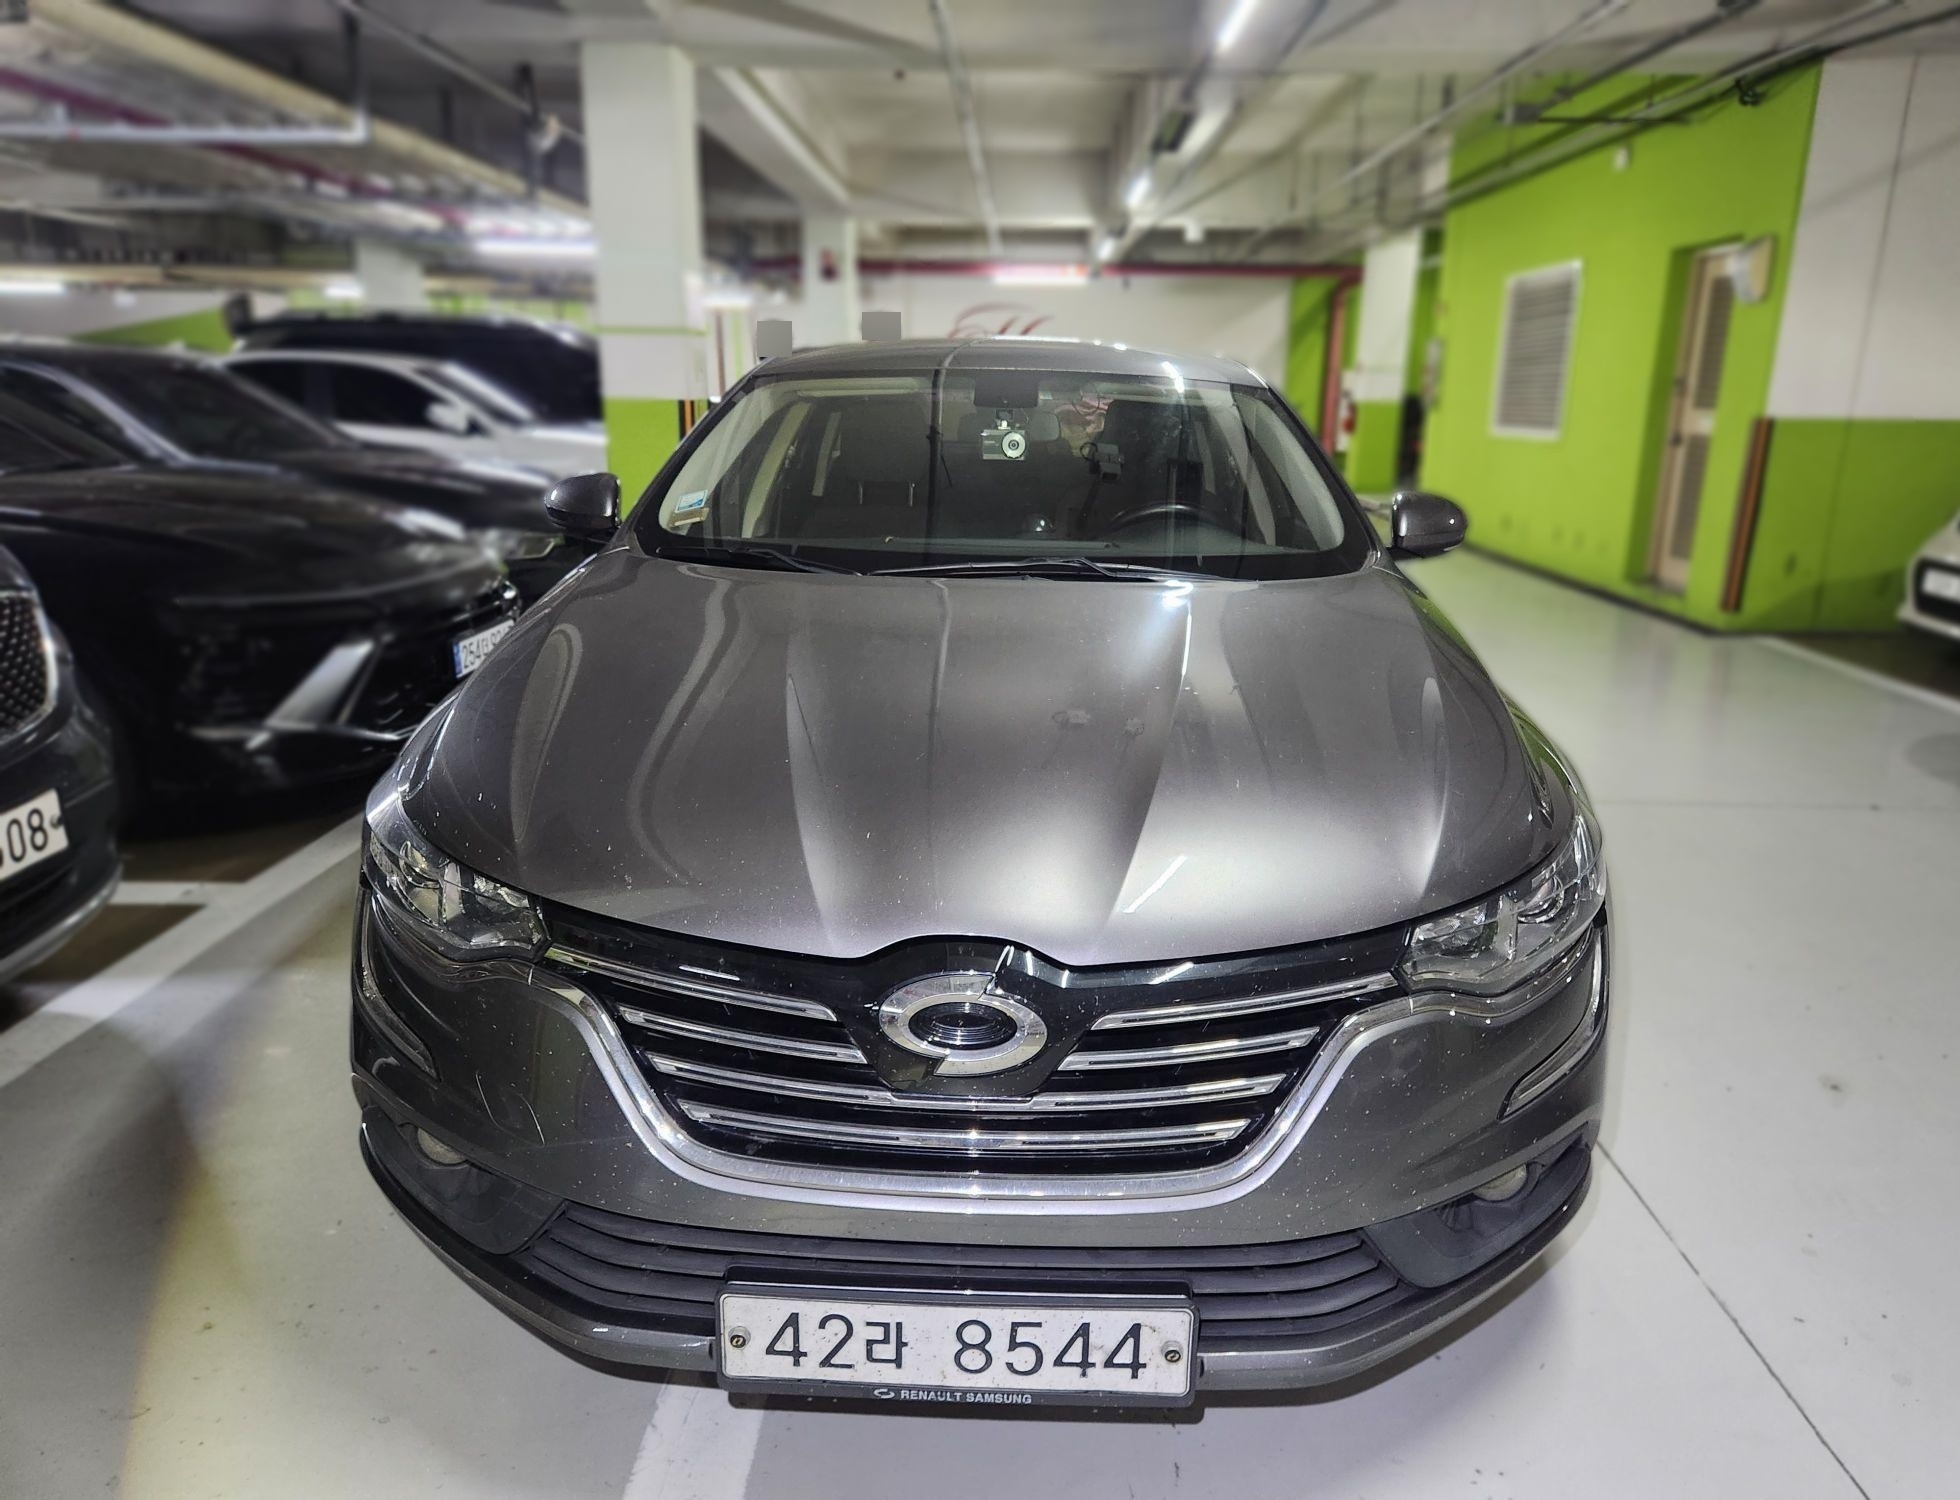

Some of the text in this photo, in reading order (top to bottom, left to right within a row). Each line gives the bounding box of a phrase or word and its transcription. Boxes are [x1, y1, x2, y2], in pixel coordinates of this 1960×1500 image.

[0, 808, 48, 868] 08
[766, 1312, 1147, 1380] 42라 8544
[900, 1389, 1032, 1404] RENAULT SAMSUNG
